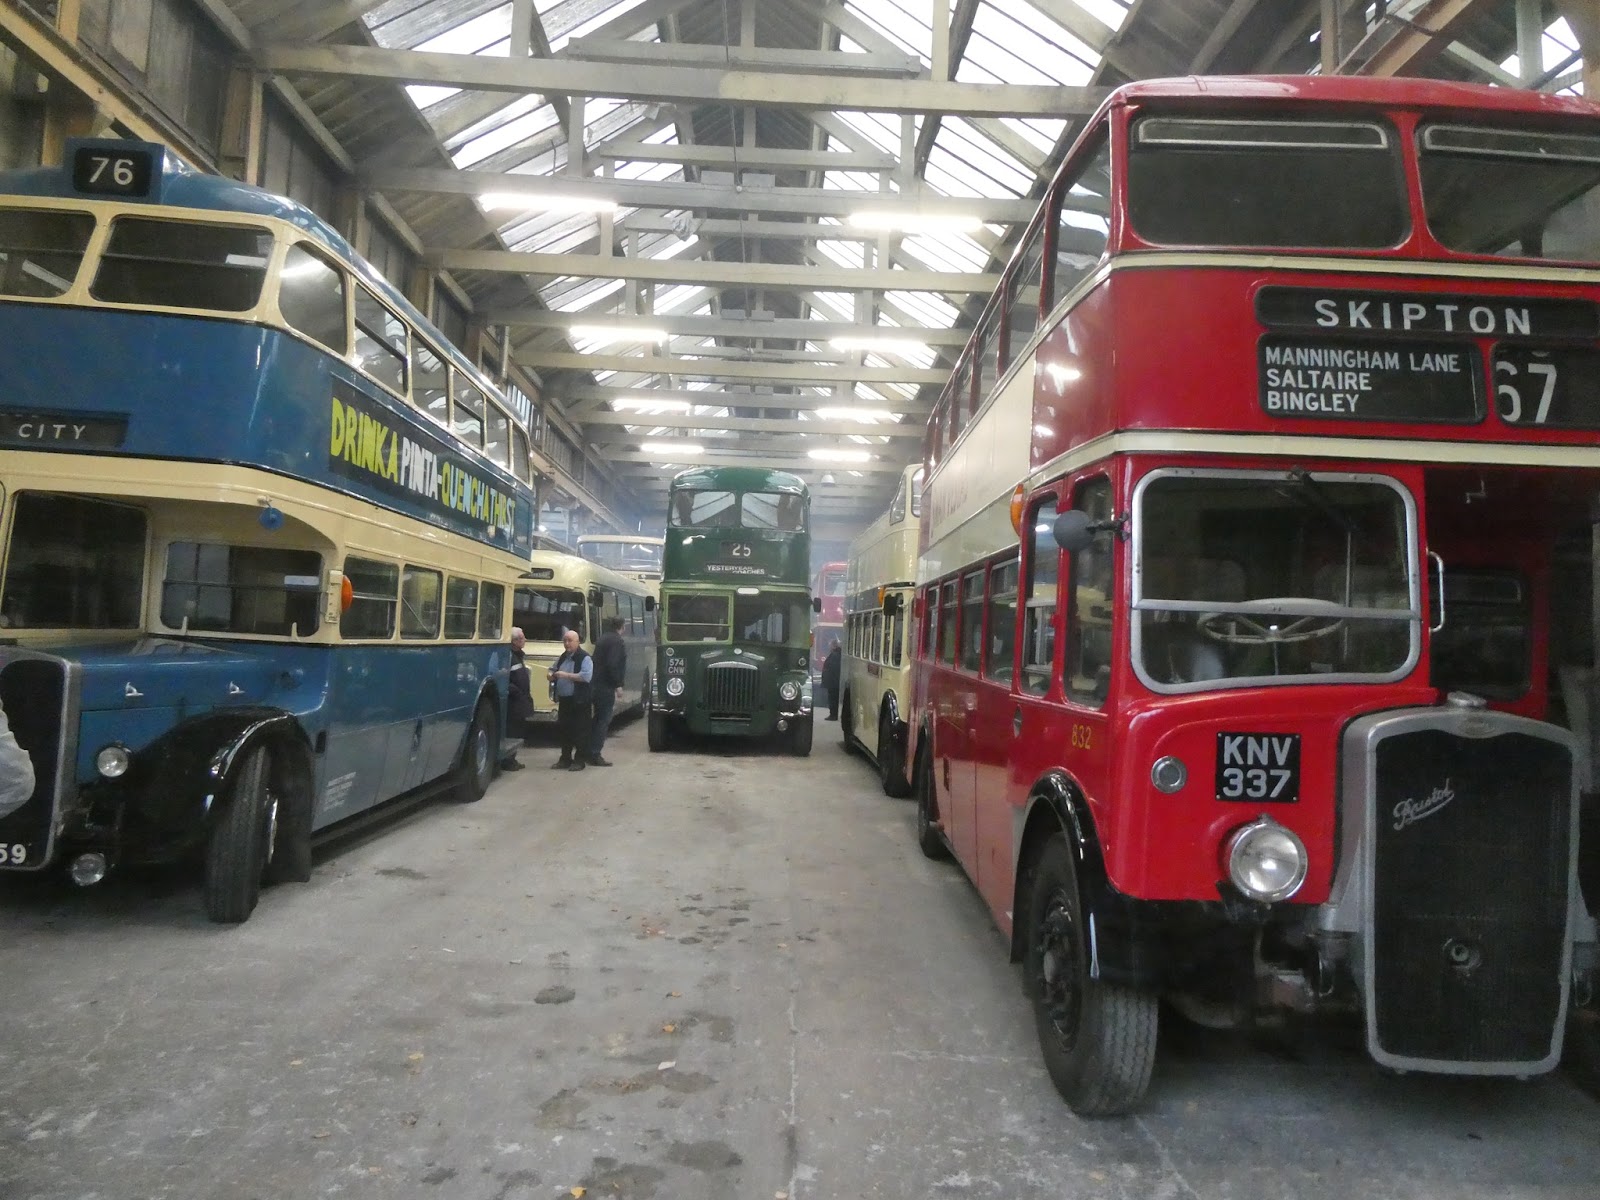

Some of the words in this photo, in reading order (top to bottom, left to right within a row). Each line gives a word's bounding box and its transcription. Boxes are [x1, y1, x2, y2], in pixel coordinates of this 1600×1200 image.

[88, 156, 134, 186] 76
[1314, 299, 1531, 336] SKIPTON
[1265, 346, 1400, 370] MANNINGHAM
[1409, 352, 1461, 373] LANE
[1266, 369, 1372, 391] SALTAIRE
[1495, 360, 1557, 424] 67
[1267, 390, 1360, 413] BINGLEY
[18, 423, 86, 440] CITY
[330, 396, 399, 484] DRINKA
[732, 543, 751, 557] 25
[669, 658, 684, 667] 574
[1071, 723, 1091, 750] 832
[1223, 735, 1293, 766] KNV
[1222, 767, 1291, 798] 337
